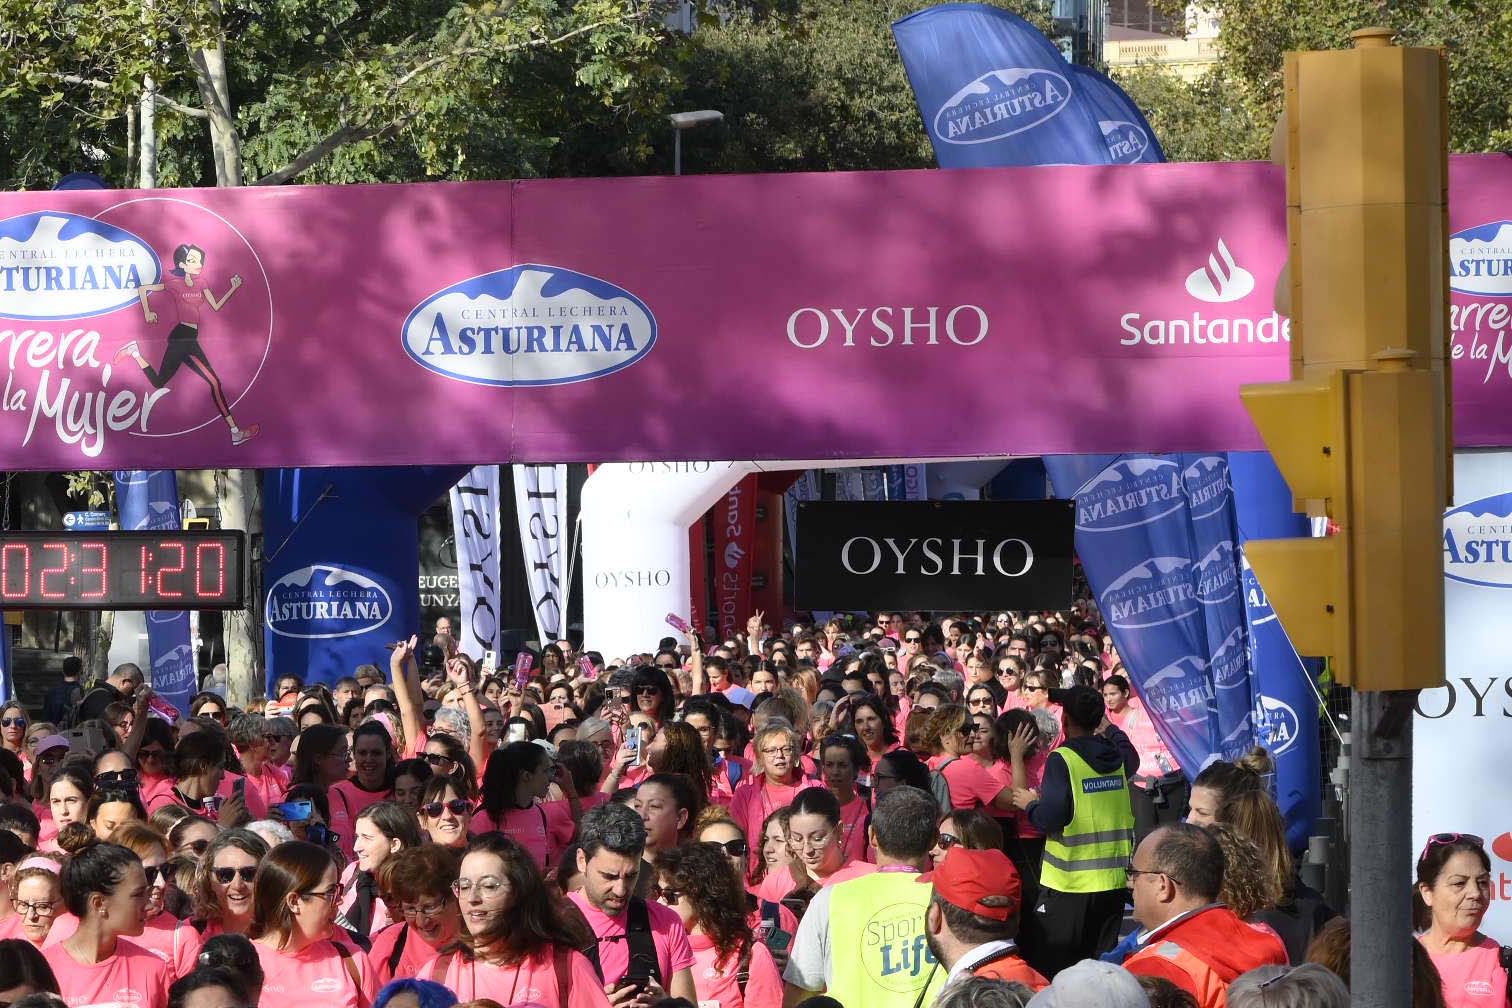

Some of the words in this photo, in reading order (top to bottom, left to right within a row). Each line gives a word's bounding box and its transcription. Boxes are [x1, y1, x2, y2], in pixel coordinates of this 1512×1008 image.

[64, 247, 136, 258] LECHERA
[1450, 257, 1512, 278] STUR
[460, 305, 540, 319] CENTRAL
[547, 304, 629, 317] LECHERA
[1450, 301, 1512, 332] arre
[422, 312, 637, 356] ASTURIANA
[786, 305, 989, 348] OYSHO
[1120, 311, 1291, 346] Santande
[2, 371, 27, 412] la
[22, 362, 171, 458] Mujer
[1467, 525, 1512, 535] CENT
[841, 536, 1034, 577] OYSHO
[1442, 527, 1512, 564] ASTU
[419, 576, 458, 589] EUGE
[595, 569, 671, 589] OYSHO
[270, 595, 383, 623] ASTURIANA
[282, 590, 326, 600] CENTRAL
[328, 590, 378, 599] LECHERA
[420, 594, 460, 607] UNYA
[1412, 677, 1512, 719] OYS
[867, 914, 923, 947] Spor
